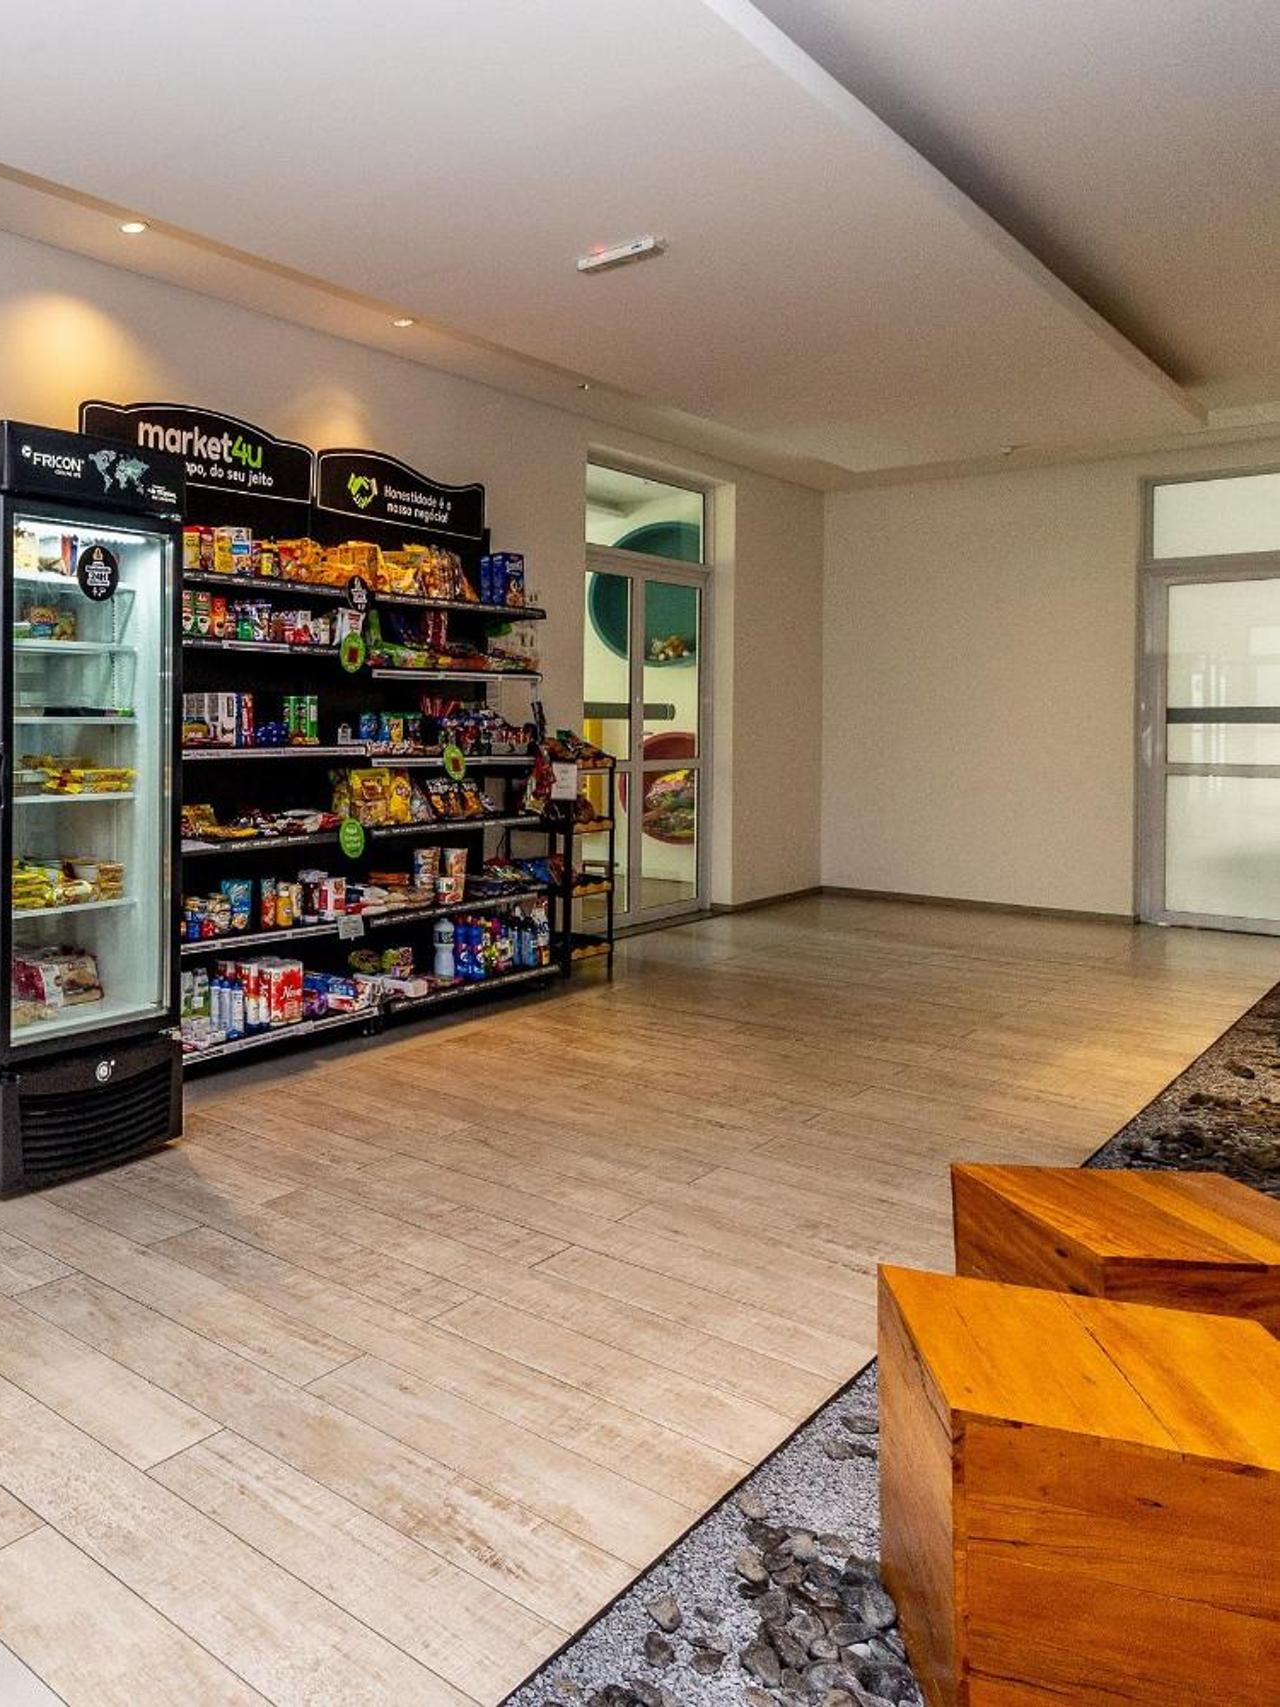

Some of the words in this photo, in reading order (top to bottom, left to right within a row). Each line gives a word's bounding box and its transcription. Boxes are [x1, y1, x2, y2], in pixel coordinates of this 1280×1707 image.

[137, 421, 263, 468] market4u
[33, 452, 82, 472] FRICON
[209, 463, 224, 478] do
[227, 470, 245, 482] seu
[247, 470, 274, 487] jeito
[384, 485, 437, 507] Honestidade
[387, 503, 412, 516] nosso
